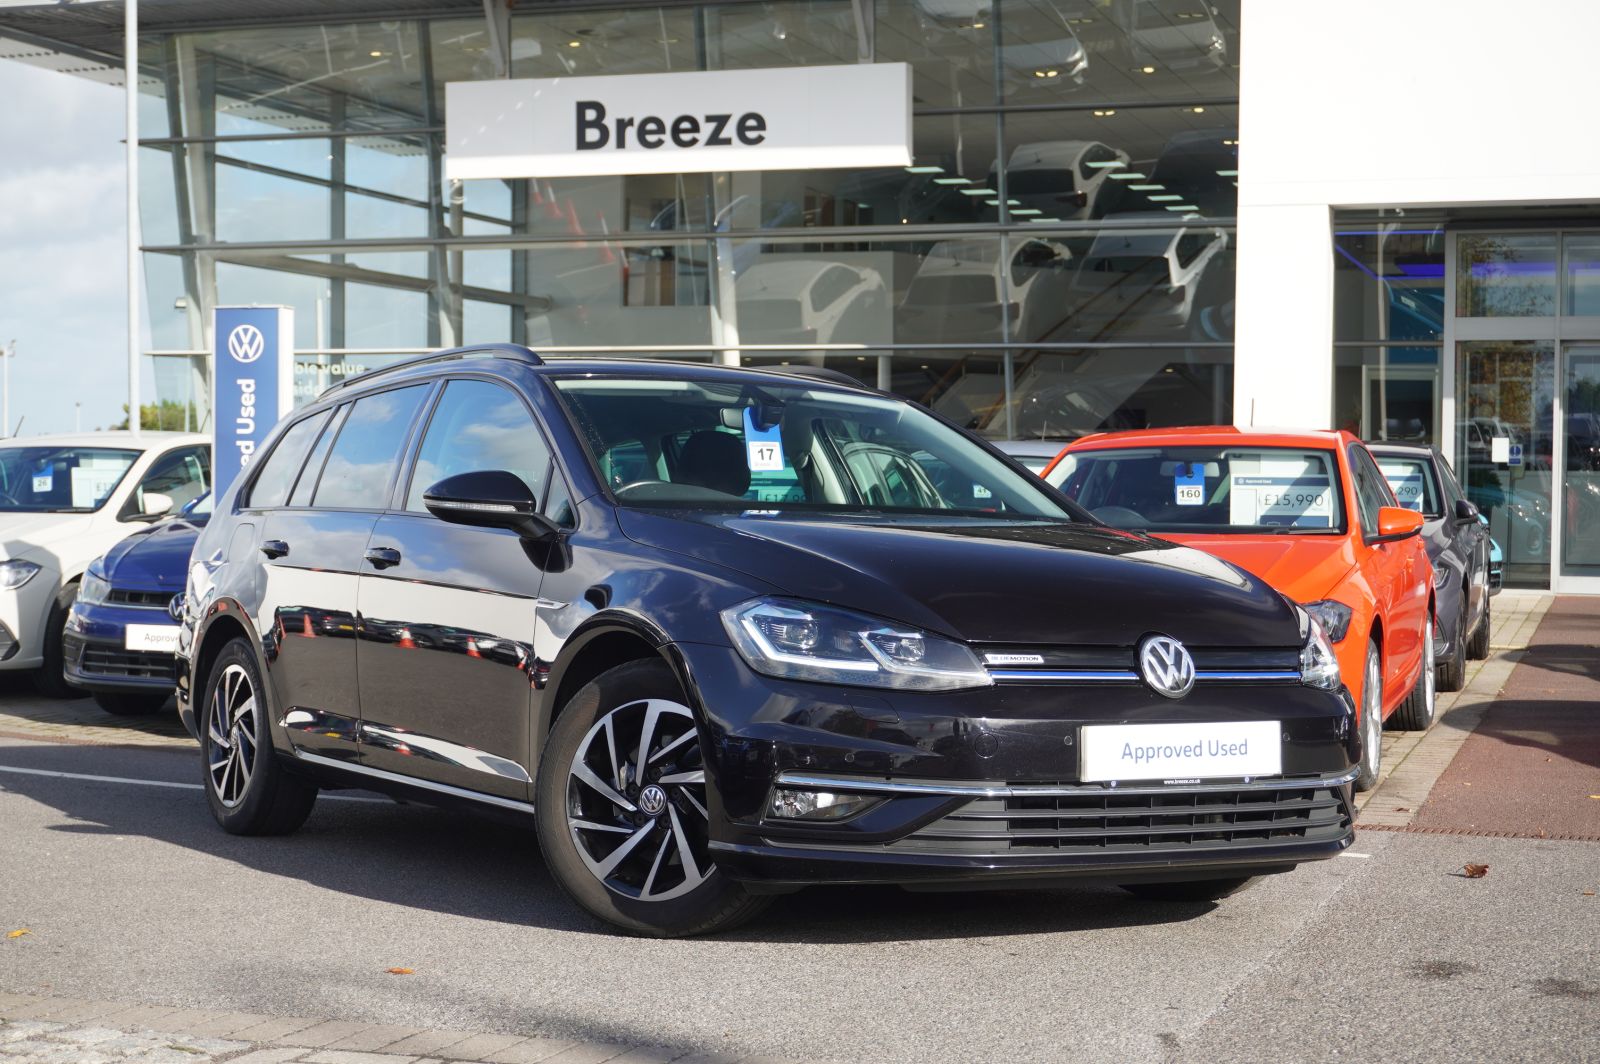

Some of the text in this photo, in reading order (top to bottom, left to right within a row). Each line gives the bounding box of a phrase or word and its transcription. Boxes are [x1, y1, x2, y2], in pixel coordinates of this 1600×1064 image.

[576, 100, 766, 150] Breeze
[319, 361, 365, 375] value
[236, 379, 256, 434] Used
[758, 448, 774, 460] 17
[1180, 490, 1200, 498] 160
[1264, 494, 1323, 508] £15,990
[1121, 738, 1248, 764] Approved Used
